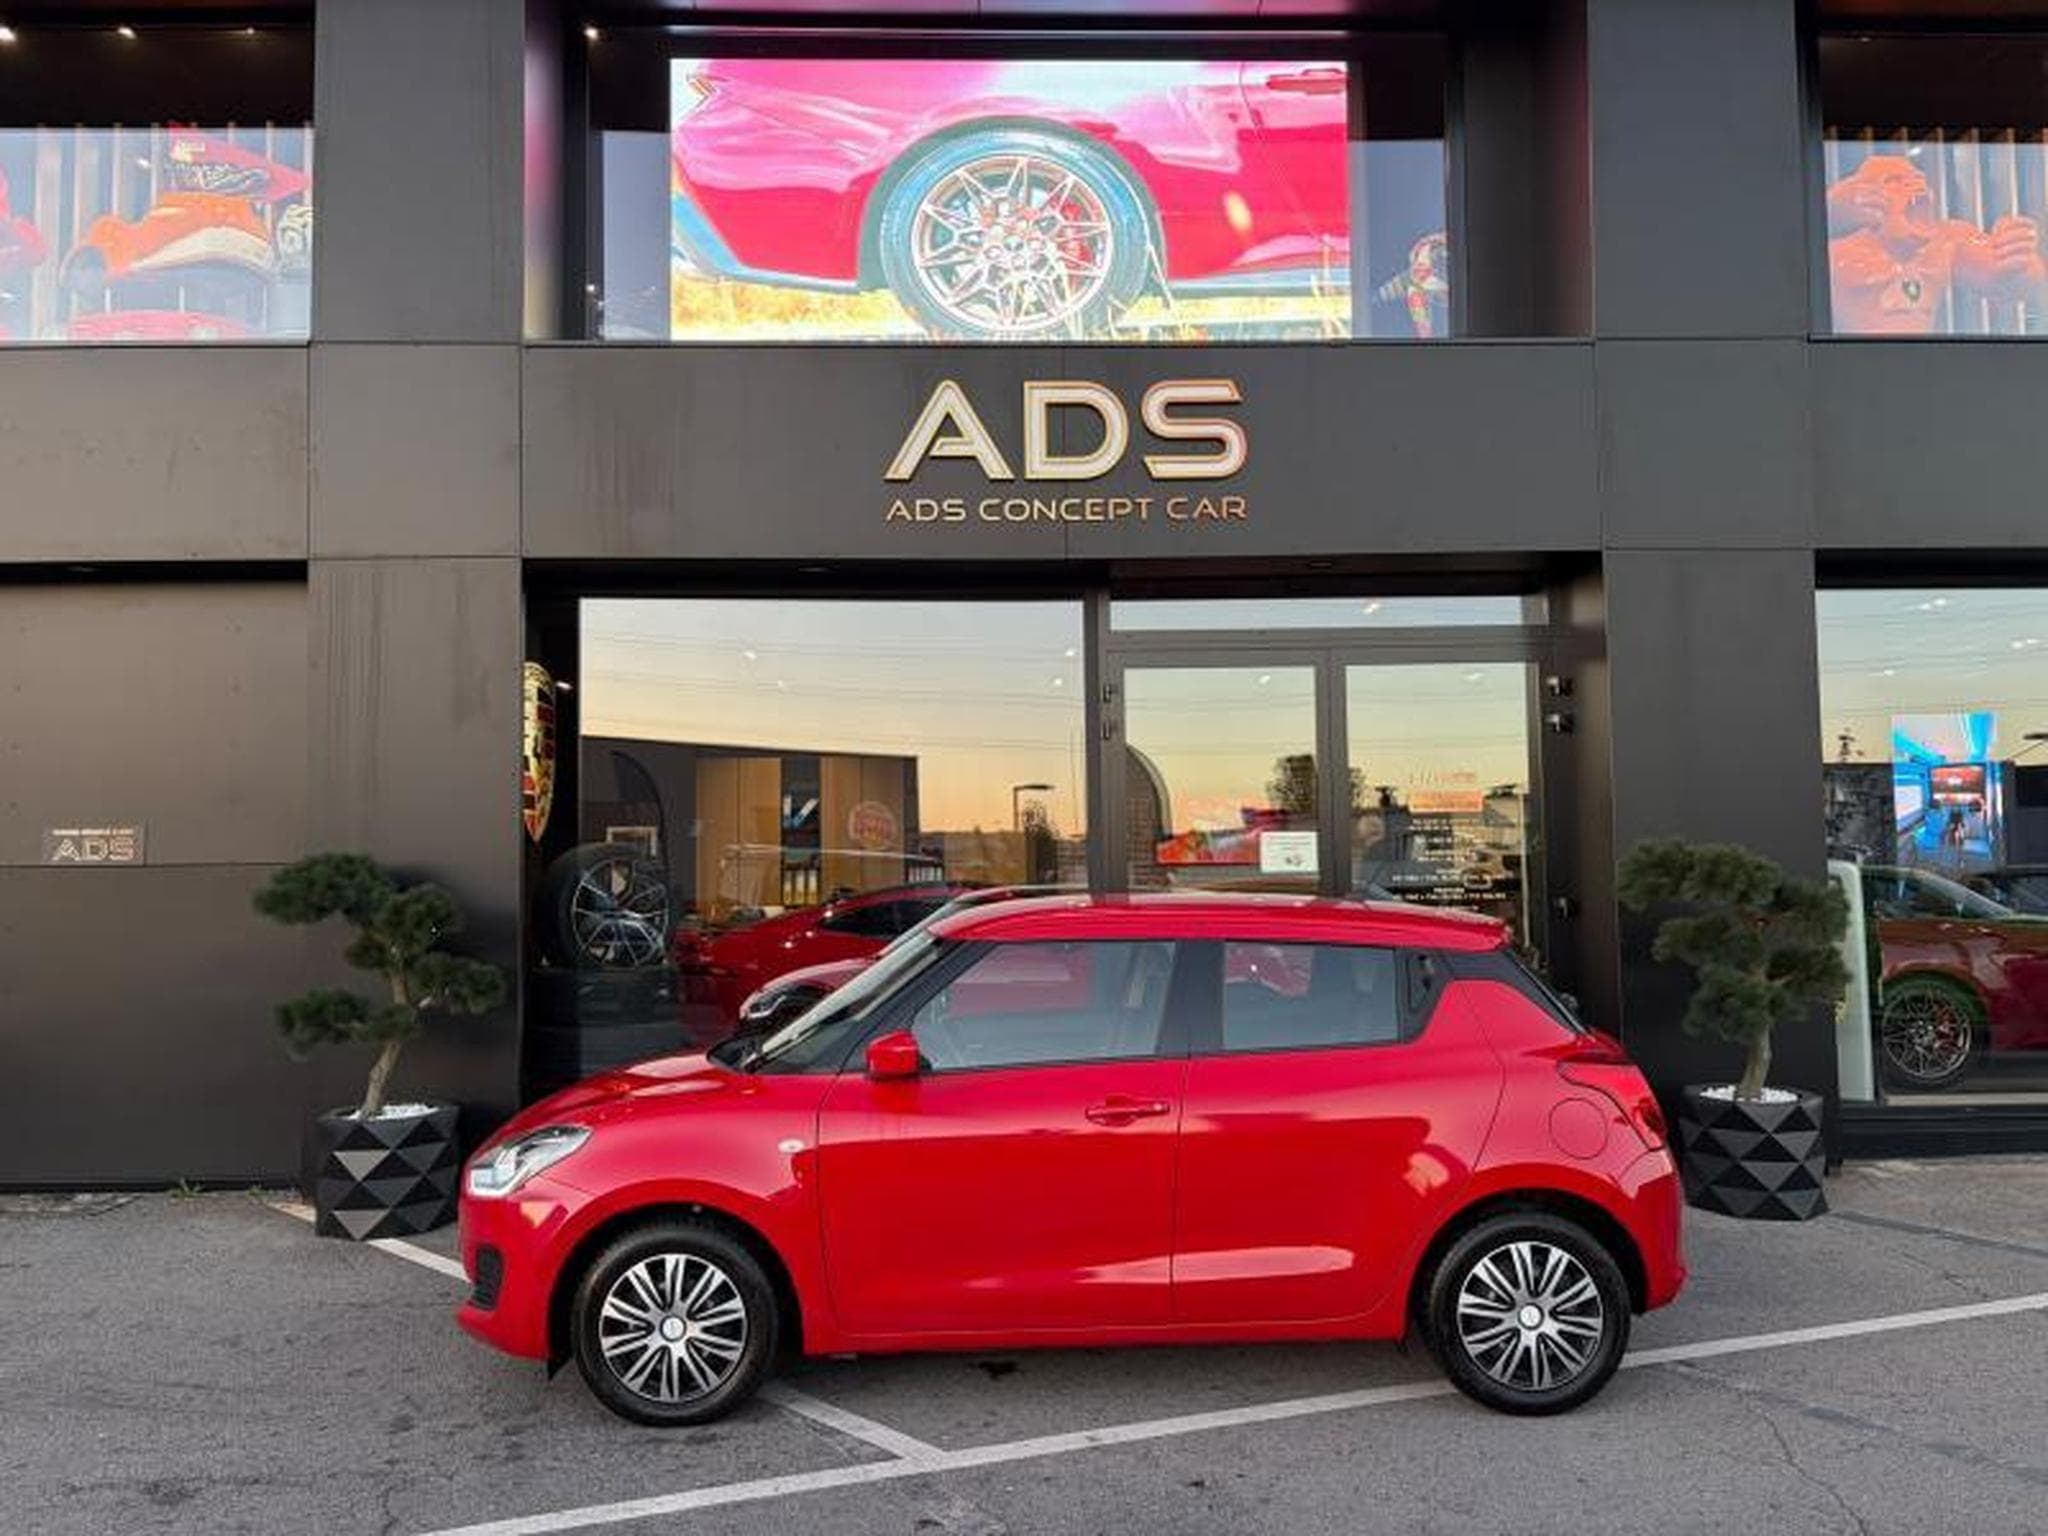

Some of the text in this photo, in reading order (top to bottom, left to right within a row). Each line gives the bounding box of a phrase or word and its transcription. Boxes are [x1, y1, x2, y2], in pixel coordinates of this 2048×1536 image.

[884, 379, 1248, 481] ADS
[886, 495, 1248, 522] ADS CONCEPT CAR
